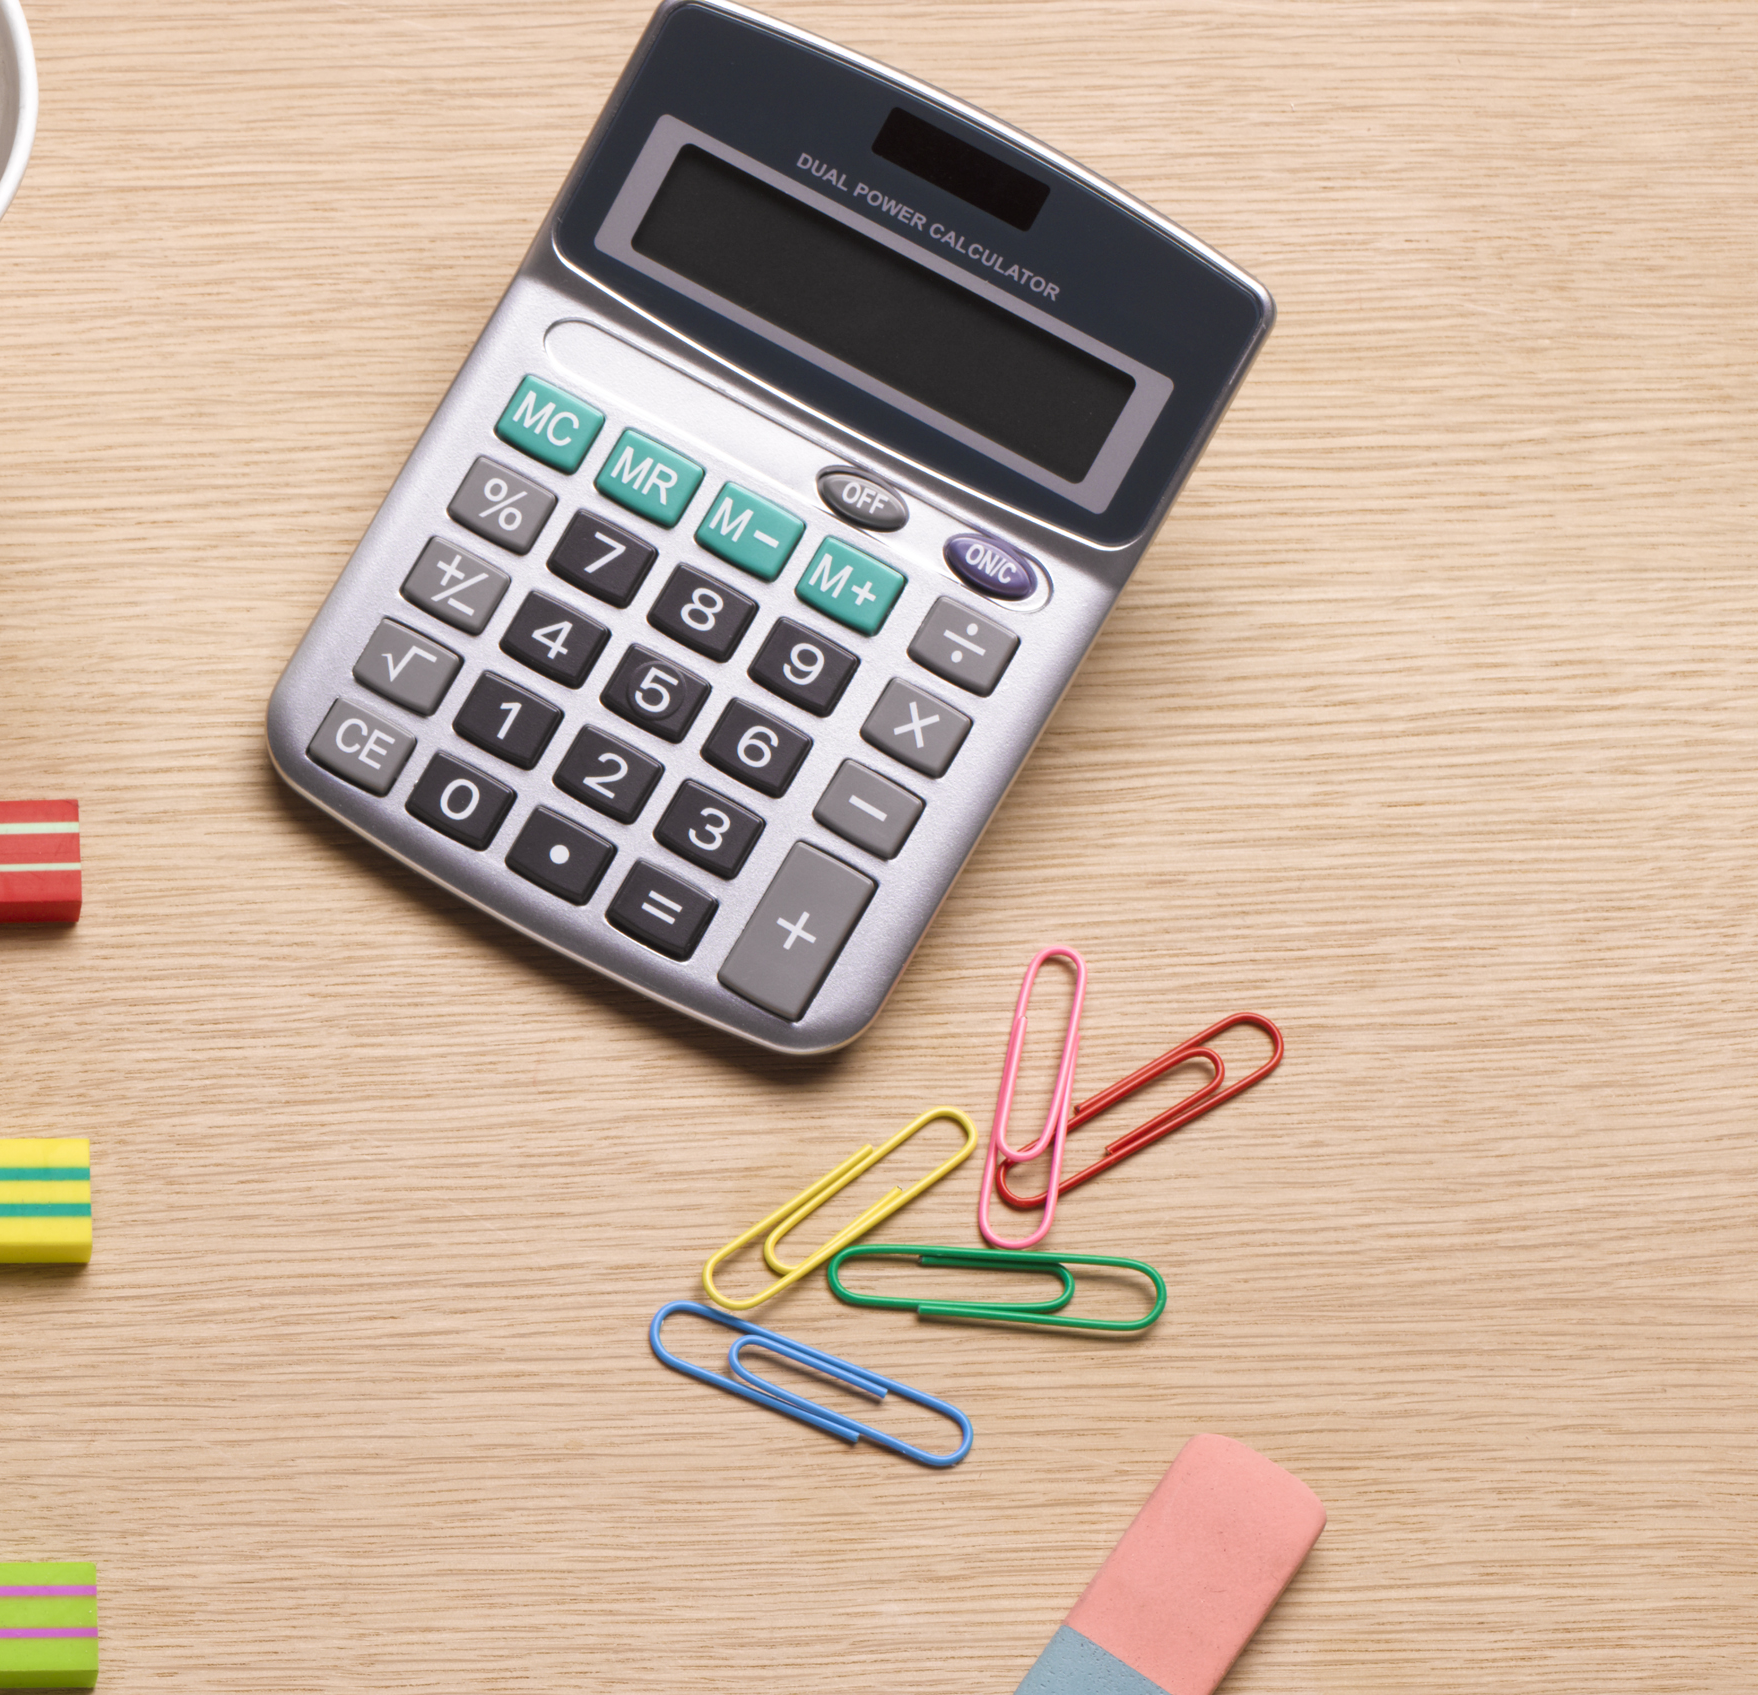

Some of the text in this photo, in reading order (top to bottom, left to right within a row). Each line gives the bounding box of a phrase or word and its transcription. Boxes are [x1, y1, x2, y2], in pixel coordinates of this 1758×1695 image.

[796, 152, 1061, 302] DUAL POWER CALCULATOR
[512, 390, 580, 446] MC
[610, 445, 678, 505] MR
[479, 477, 528, 531] %
[843, 480, 891, 516] OFF
[584, 531, 627, 574] 7
[963, 541, 1017, 585] ON/C
[808, 553, 876, 606] M+
[680, 587, 724, 632] 8
[531, 620, 573, 659] 4
[783, 642, 825, 686] 9
[634, 666, 679, 713] 5
[497, 701, 522, 740] 1
[335, 718, 396, 770] CE
[737, 725, 779, 768] 6
[583, 752, 629, 799] 2
[440, 778, 480, 821] 0
[688, 807, 731, 851] 3
[641, 890, 683, 925] =
[776, 911, 817, 950] +
